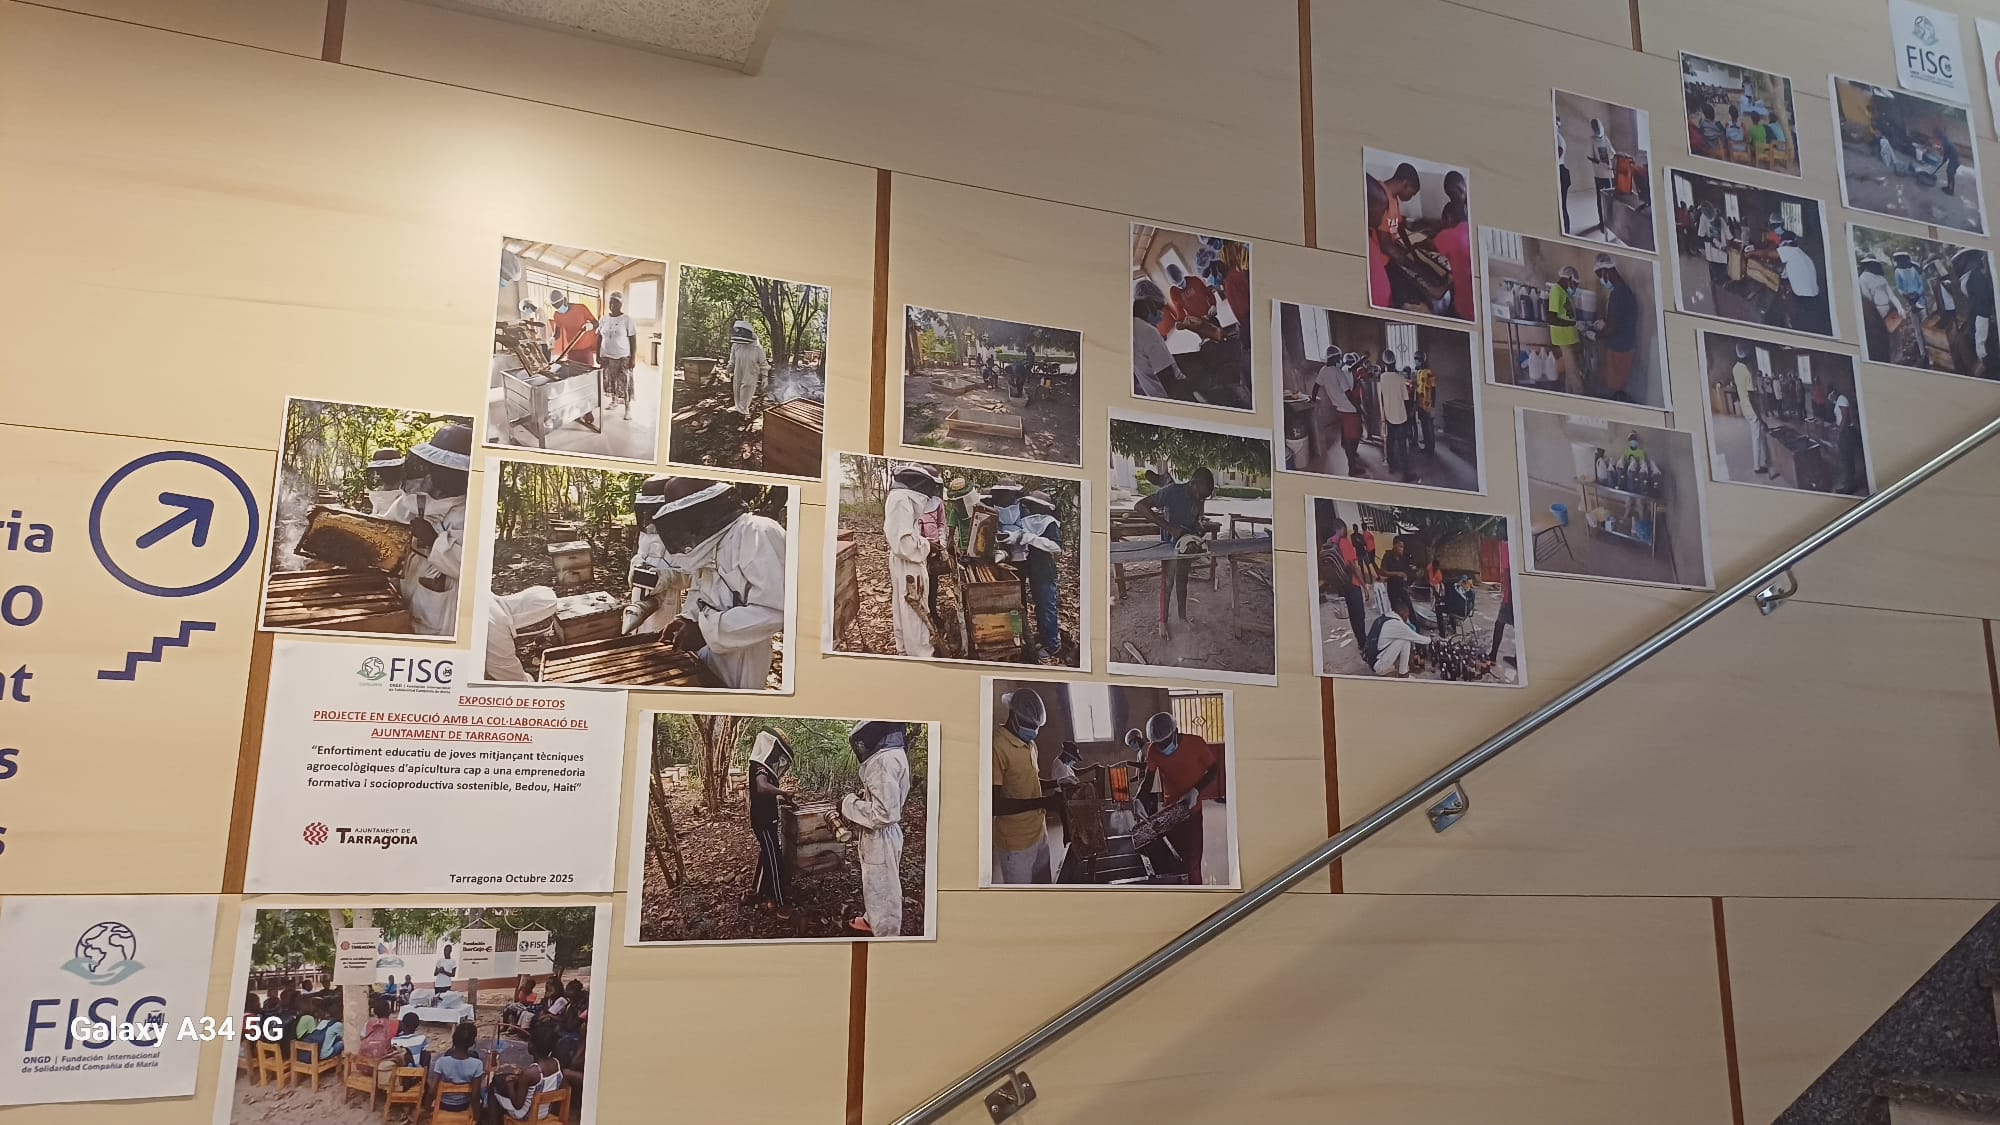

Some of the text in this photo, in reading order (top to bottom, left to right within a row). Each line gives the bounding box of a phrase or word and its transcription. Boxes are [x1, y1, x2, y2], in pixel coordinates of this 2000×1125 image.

[1906, 45, 1952, 78] FISC
[389, 657, 454, 684] FISC
[458, 695, 566, 709] EXPOSICIÓ DE FOTOS
[313, 711, 589, 729] PROJECTE EN EXECUCIÓ AMB LA COL·LABORACIÓ DEL
[370, 728, 533, 742] AJUNTAMENT DE TARRAGONA:
[385, 748, 431, 758] educatiu
[433, 749, 447, 758] de
[449, 749, 477, 760] joves
[479, 750, 534, 762] mitjançant
[536, 751, 584, 763] tècniques
[306, 761, 395, 774] agroecològiques
[398, 763, 461, 776] d'apicultura
[463, 767, 481, 777] cap
[493, 768, 512, 776] una
[514, 767, 586, 778] emprenedoria
[308, 777, 361, 788] formativa
[363, 779, 367, 788] i
[370, 779, 454, 791] socioproductiva
[456, 781, 512, 793] sostenible,
[515, 782, 550, 793] Bedou,
[449, 873, 574, 886] Tarragona Octubre 2025
[529, 940, 547, 949] FISC
[24, 996, 167, 1052] FISC
[23, 1055, 51, 1065] ONGD
[106, 1051, 161, 1062] Internacional
[21, 1065, 33, 1074] de
[34, 1063, 81, 1074] Solidaridad
[124, 1061, 135, 1070] de
